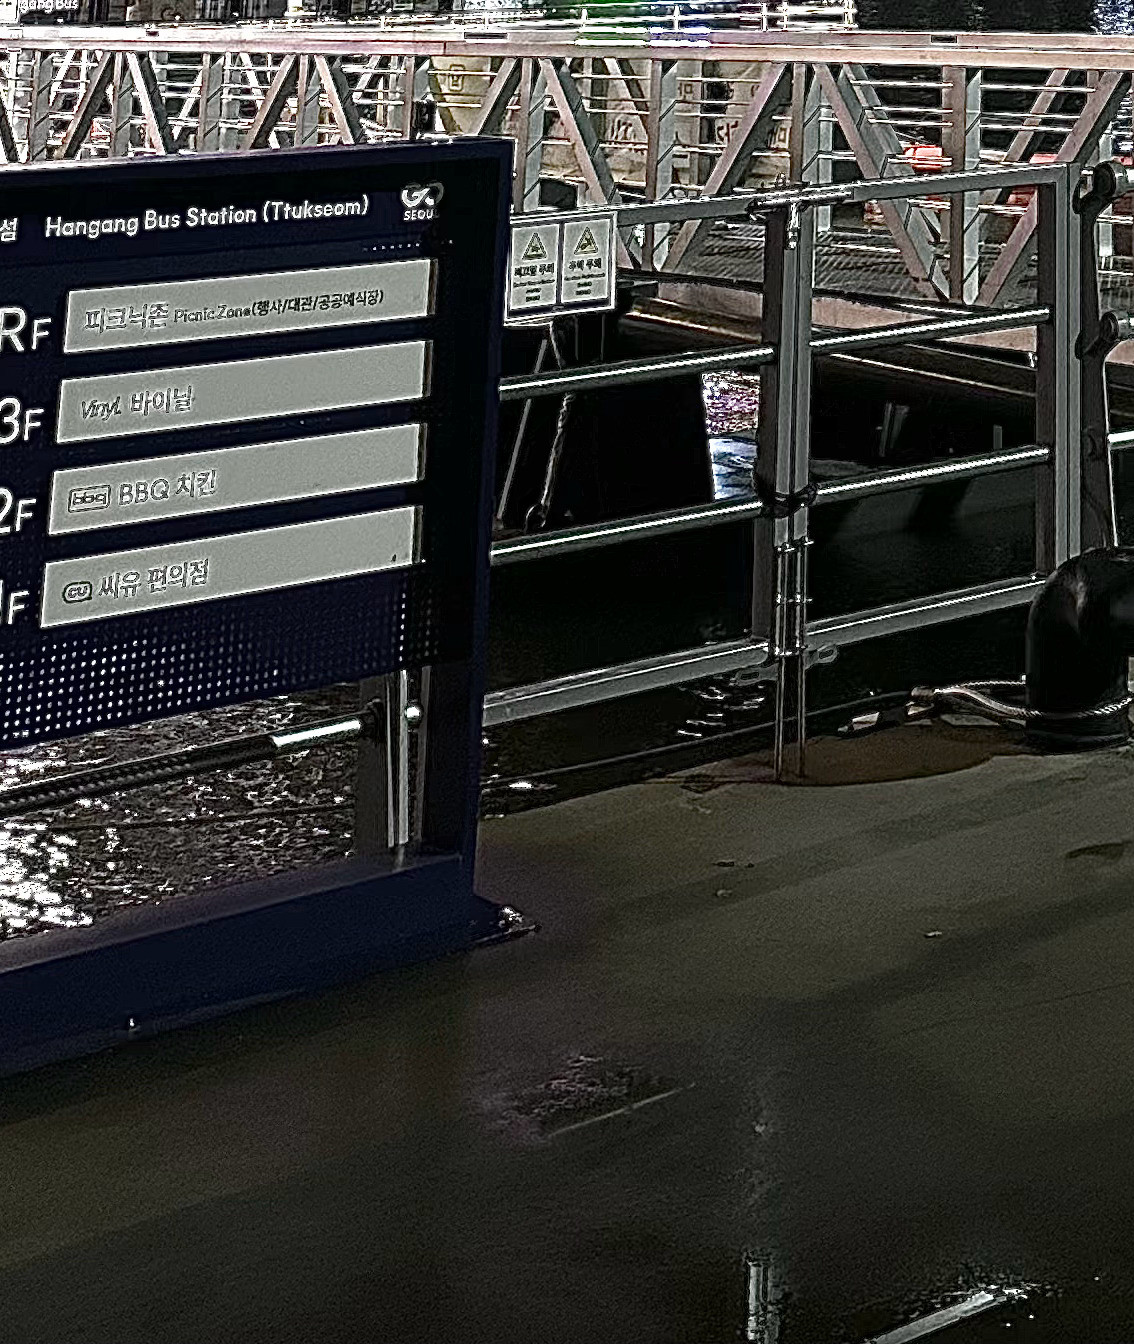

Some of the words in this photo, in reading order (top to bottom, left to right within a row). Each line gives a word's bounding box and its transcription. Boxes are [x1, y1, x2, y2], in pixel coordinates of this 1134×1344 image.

[45, 215, 139, 240] Hangang
[143, 208, 180, 231] Bus
[185, 205, 257, 227] Station
[262, 194, 370, 223] (Ttukseom)
[0, 306, 52, 352] RF
[84, 303, 169, 333] 피크닉존
[173, 307, 215, 323] Picnic
[0, 397, 45, 445] 3F
[0, 486, 37, 535] 2F
[117, 478, 170, 506] BBQ
[175, 469, 217, 498] 치킨
[67, 585, 88, 599] CU
[98, 571, 142, 600] 씨유
[147, 558, 209, 594] 편의점
